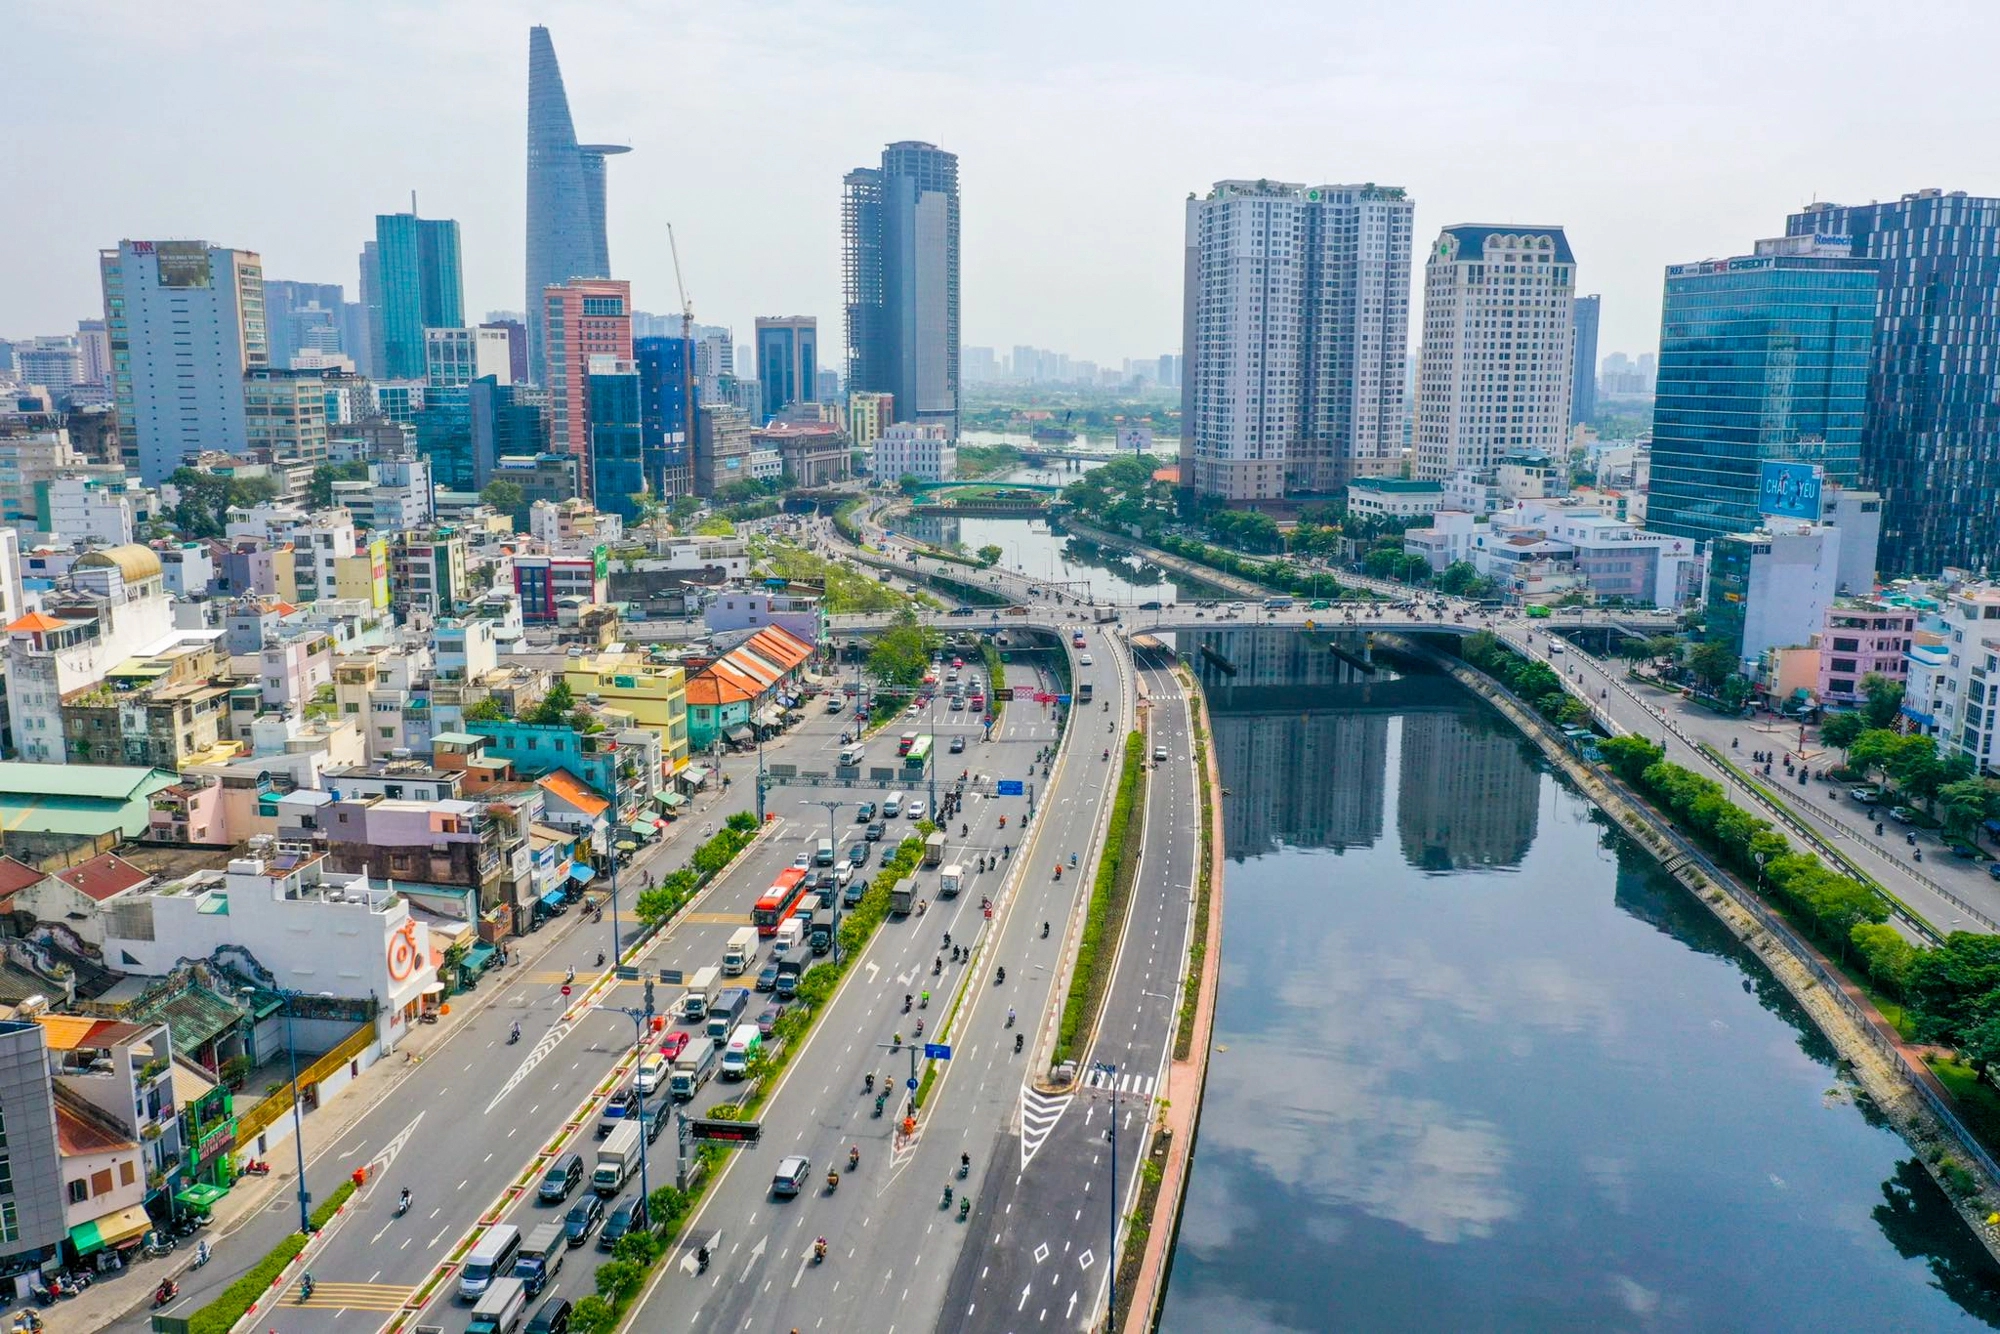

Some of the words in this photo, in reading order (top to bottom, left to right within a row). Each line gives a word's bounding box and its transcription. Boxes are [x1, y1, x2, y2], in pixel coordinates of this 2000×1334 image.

[1814, 234, 1852, 246] Reetech
[132, 241, 153, 252] TNR
[1728, 257, 1773, 270] CREDIT
